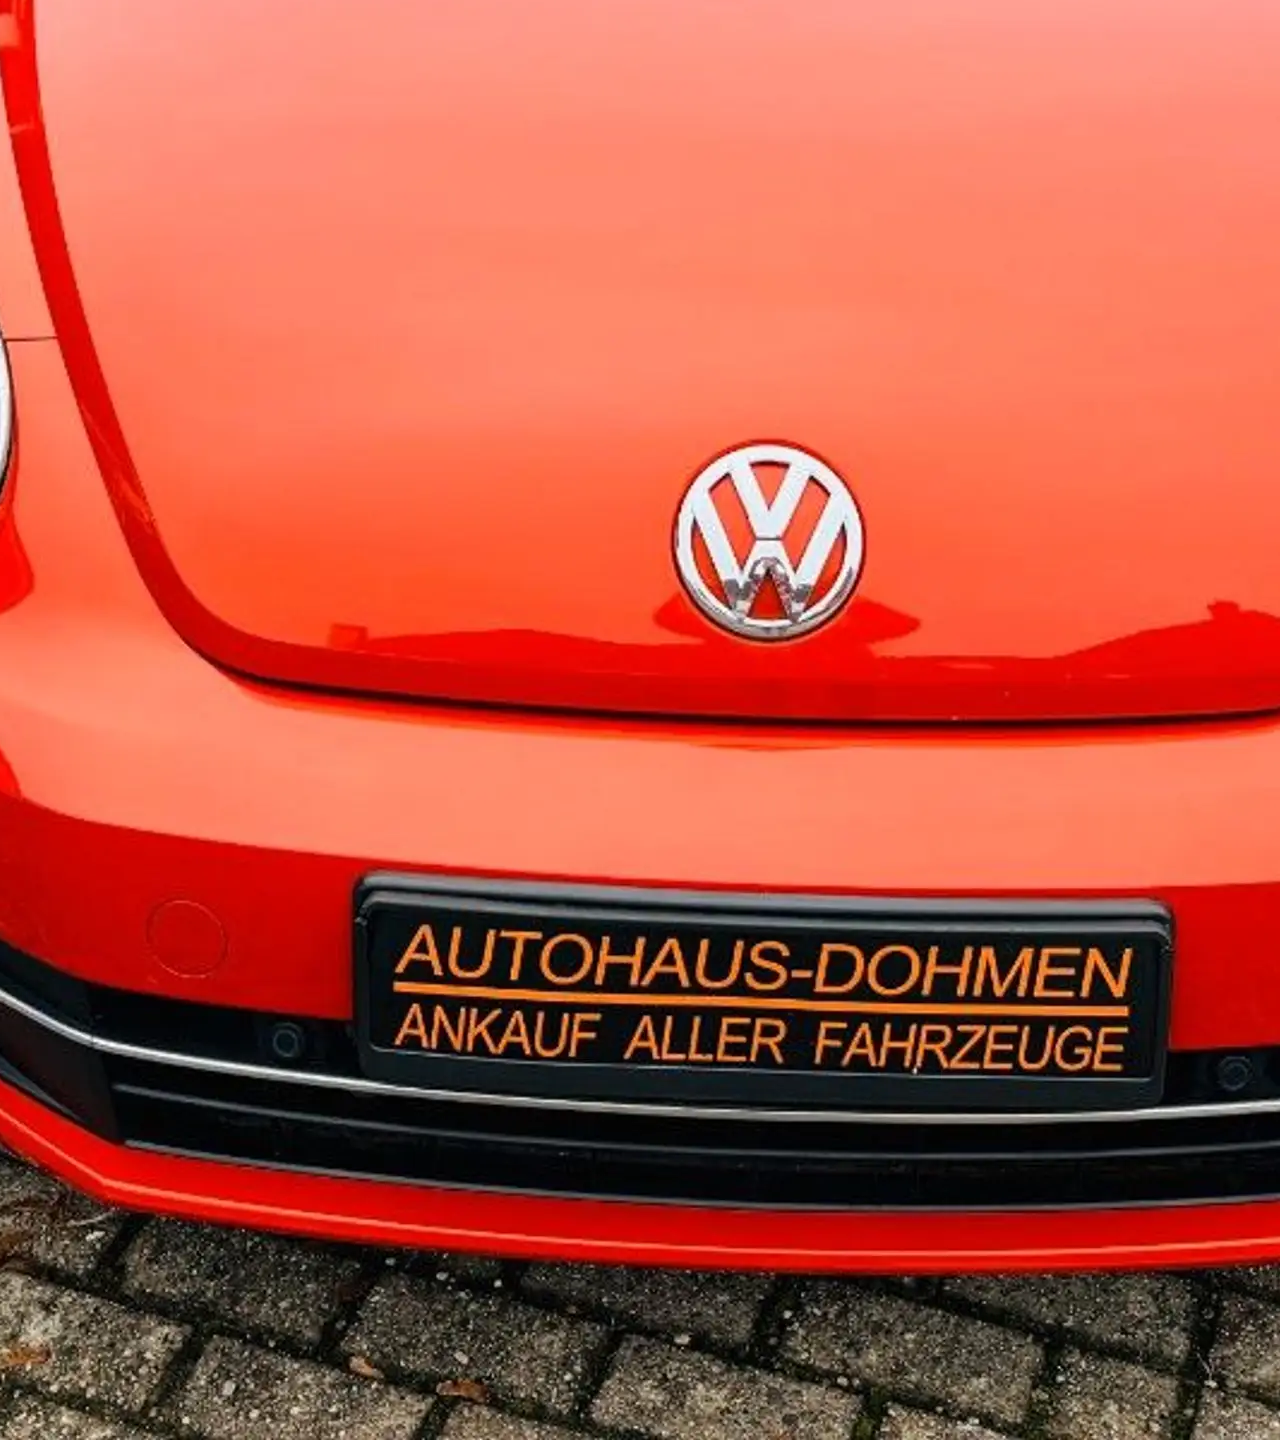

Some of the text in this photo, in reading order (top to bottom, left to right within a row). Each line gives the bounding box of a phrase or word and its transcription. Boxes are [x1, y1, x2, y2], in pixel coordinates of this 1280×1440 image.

[394, 923, 1133, 998] AUTOHAUS-DOHMEN
[394, 1003, 1129, 1071] ANKAUF ALLER FAHRZEUGE
